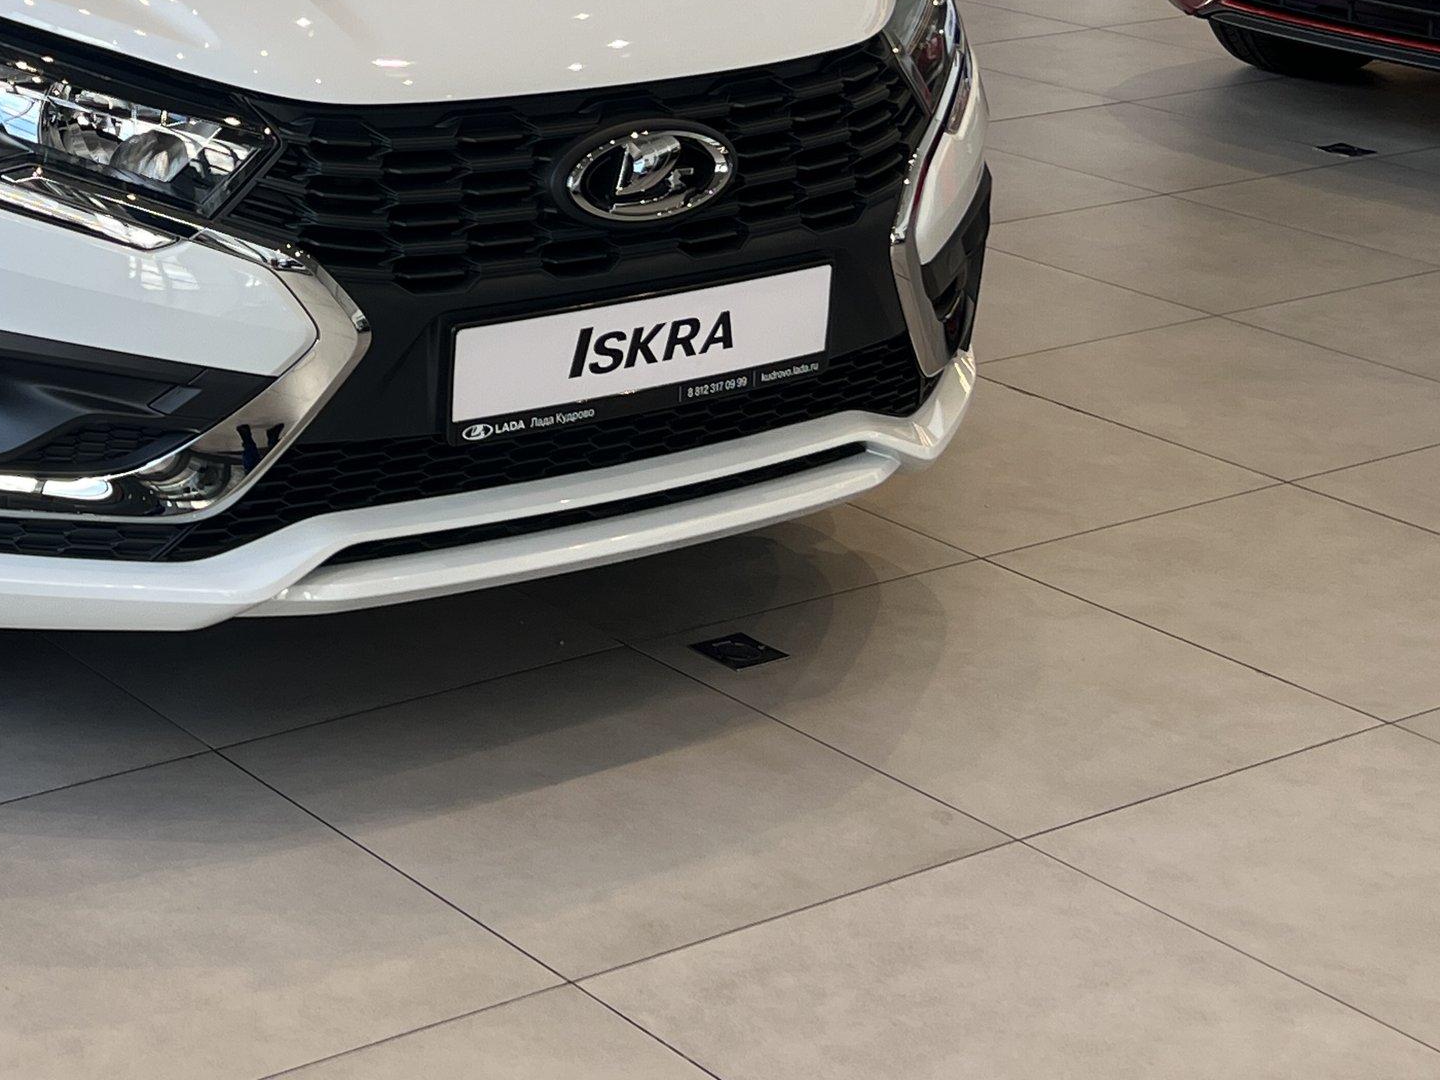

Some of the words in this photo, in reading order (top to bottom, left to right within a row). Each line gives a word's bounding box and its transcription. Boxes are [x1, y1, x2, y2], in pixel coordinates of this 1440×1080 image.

[761, 362, 819, 382] kudrovo.lada.ru
[687, 387, 694, 398] 8
[694, 385, 710, 396] 812
[710, 381, 724, 393] 317
[725, 379, 736, 390] 09
[736, 376, 748, 388] 99
[495, 420, 526, 434] LADA
[530, 416, 555, 428] Лада
[556, 408, 595, 424] Кудрово
